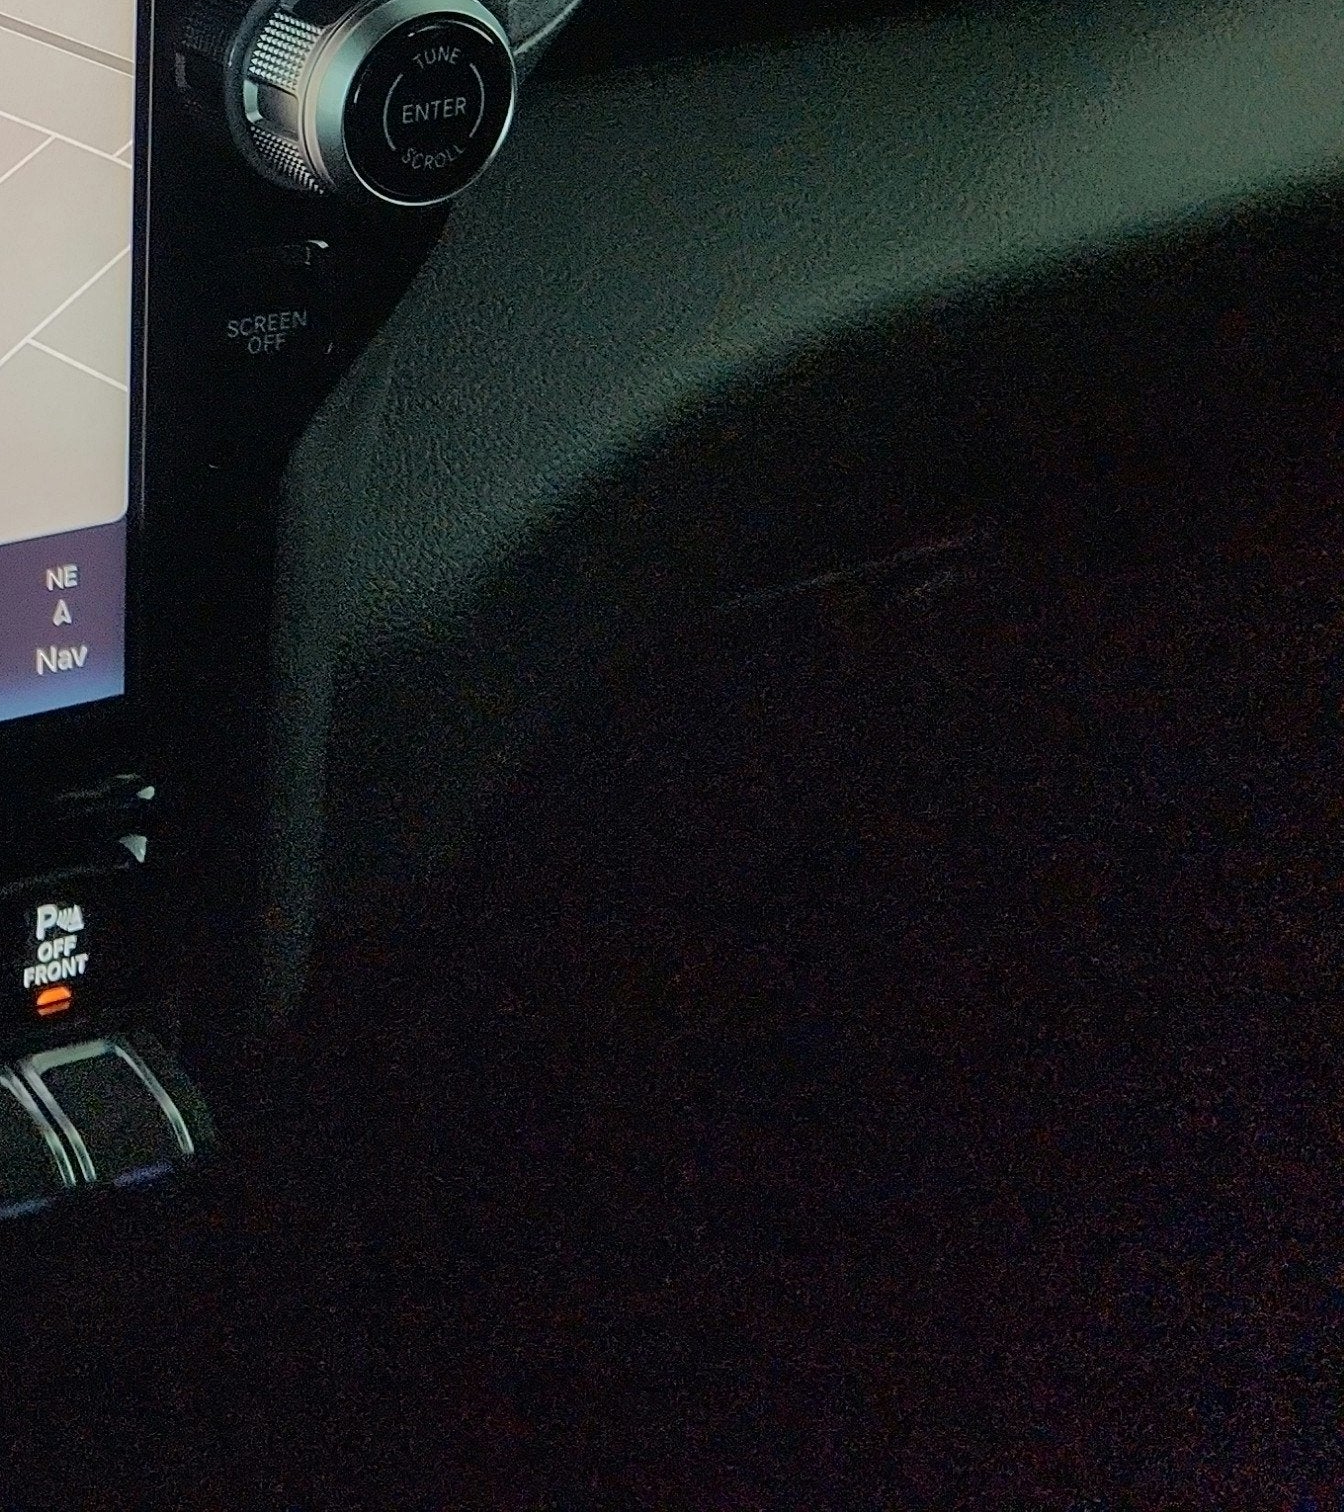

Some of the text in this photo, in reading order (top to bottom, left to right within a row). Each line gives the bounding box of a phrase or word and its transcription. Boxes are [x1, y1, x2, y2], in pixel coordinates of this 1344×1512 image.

[413, 46, 462, 69] TUNE
[402, 97, 467, 124] ENTER
[401, 144, 465, 170] SCROLL
[227, 311, 308, 338] SCREEN
[248, 332, 286, 354] OFF
[46, 564, 78, 590] NE
[35, 644, 87, 675] Nav
[37, 936, 76, 963] OFF
[24, 953, 88, 988] FRONT
